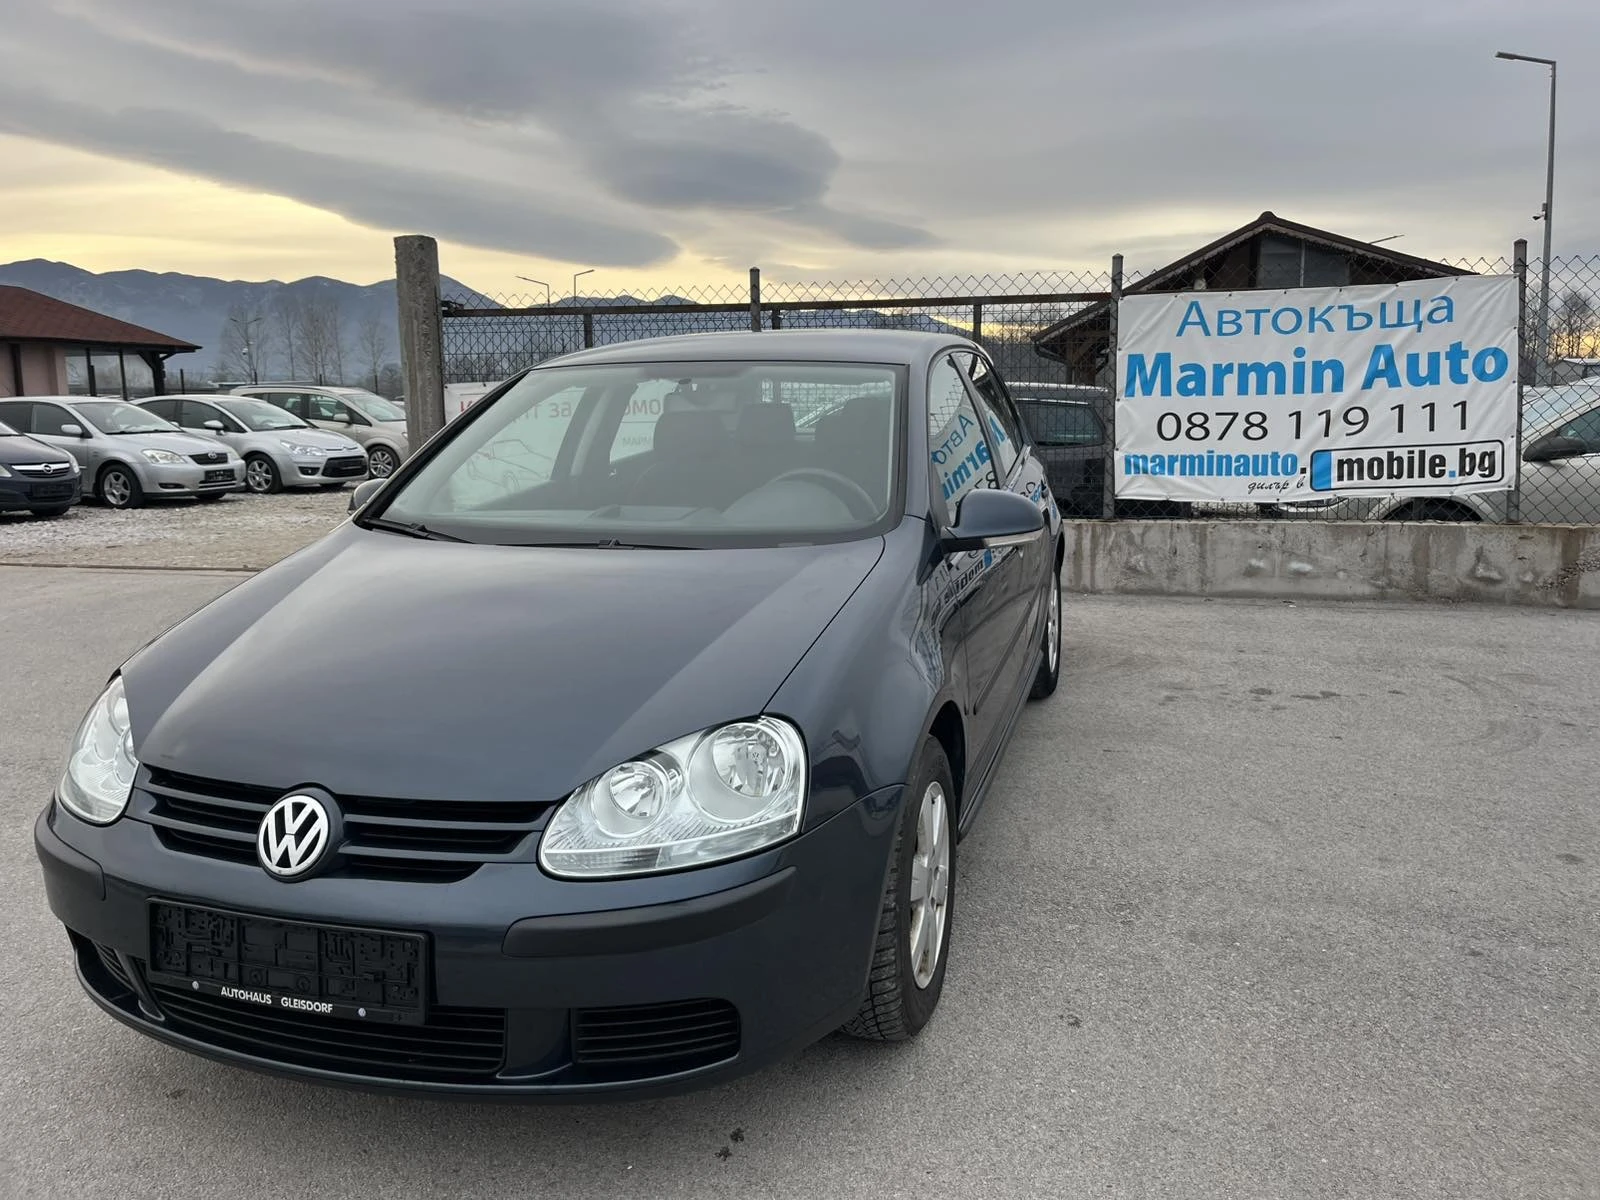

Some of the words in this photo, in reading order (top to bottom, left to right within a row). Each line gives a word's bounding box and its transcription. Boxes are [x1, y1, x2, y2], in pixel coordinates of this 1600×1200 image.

[1175, 295, 1454, 337] Автокъща
[1124, 347, 1344, 398] Marmin
[1361, 341, 1509, 391] Auto
[1156, 411, 1269, 441] 0878
[1288, 406, 1370, 439] 119
[1390, 400, 1468, 434] 111
[1336, 448, 1497, 482] mobile.bg
[220, 986, 272, 1005] AUTOHAUS
[280, 996, 334, 1014] GLEISDORF
